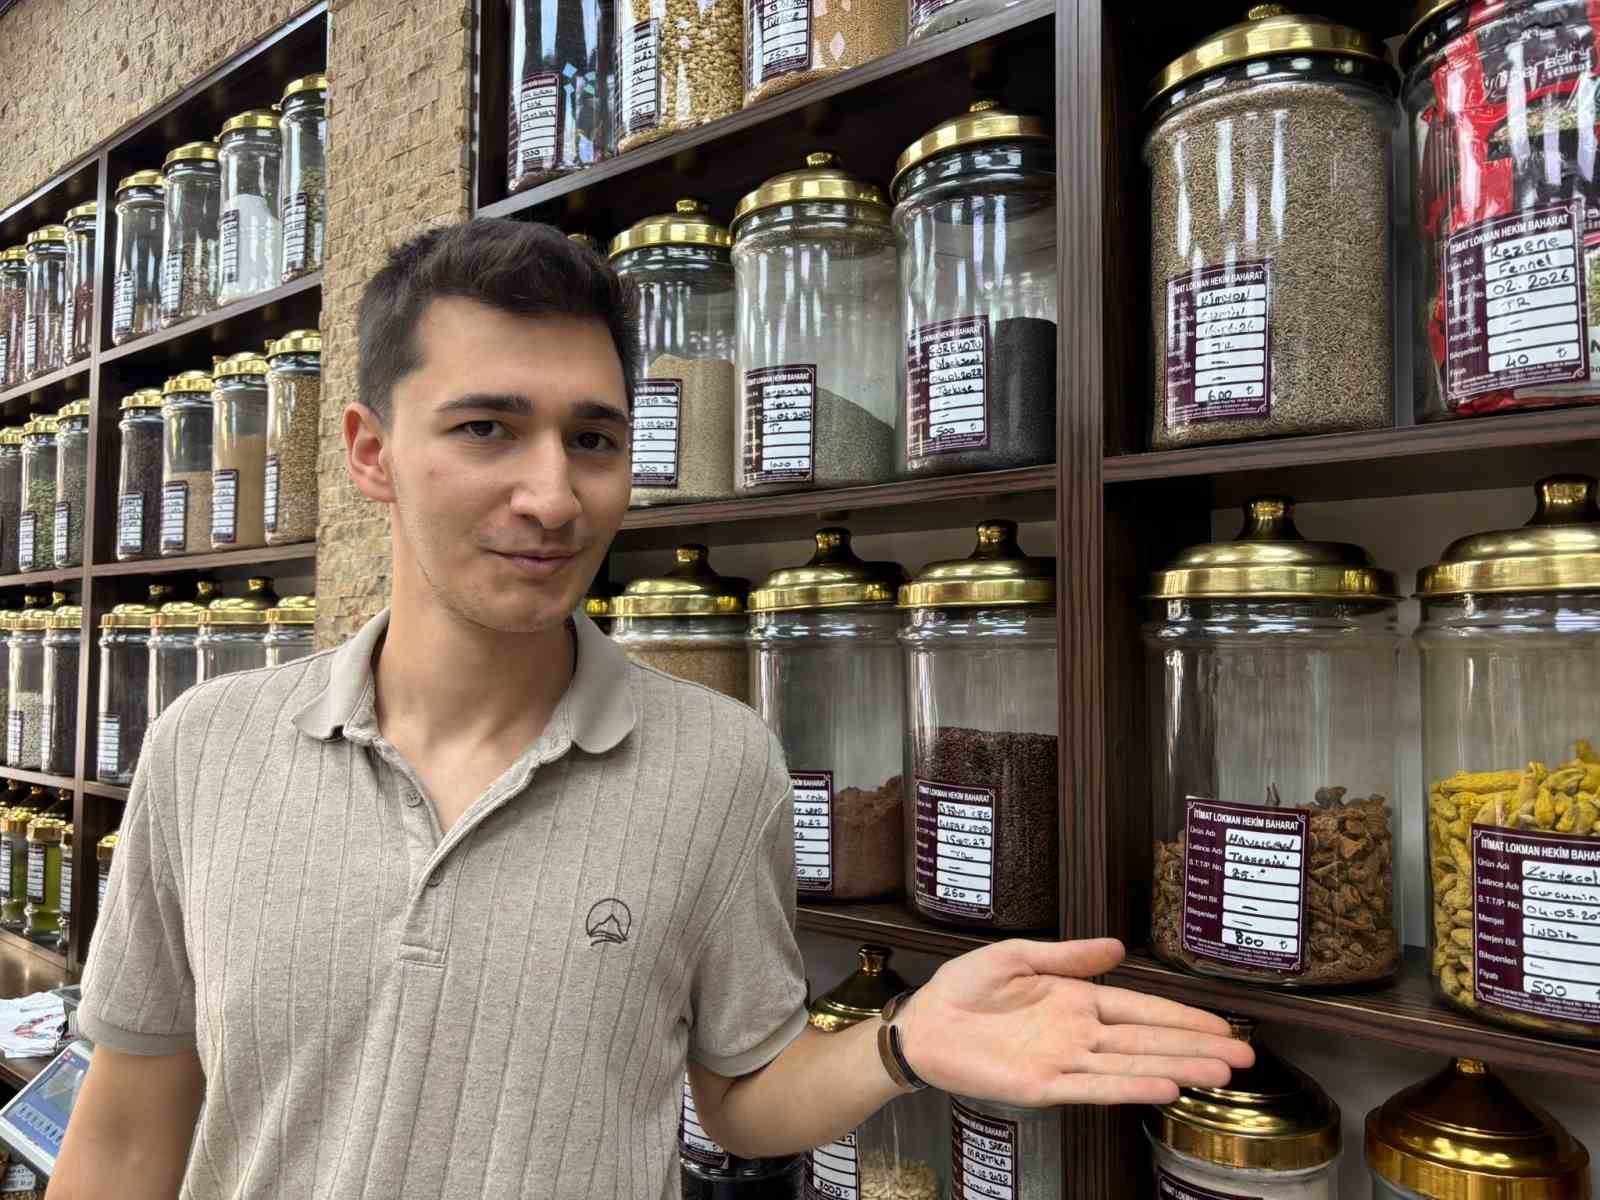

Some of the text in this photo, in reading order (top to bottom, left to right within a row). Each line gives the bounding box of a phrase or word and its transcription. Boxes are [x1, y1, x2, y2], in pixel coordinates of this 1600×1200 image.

[1470, 230, 1500, 248] LOKMAN
[1501, 221, 1528, 239] HEKİM
[1527, 214, 1569, 233] BAHARAT
[1490, 238, 1560, 259] Rezene
[1499, 255, 1553, 275] Fennel
[1230, 270, 1264, 284] BAHARAT
[1528, 270, 1571, 289] 2026
[1504, 353, 1530, 368] 40
[964, 793, 990, 802] BAHARAT
[1193, 809, 1299, 831] İTİMAT LOKMAN HEKİM BAHARAT
[1480, 838, 1504, 853] İTİMAT
[1505, 842, 1540, 858] LOKMAN
[1541, 845, 1570, 859] HEKİM
[1496, 861, 1510, 871] Adı
[1477, 876, 1520, 891] Latince Adı
[1234, 929, 1265, 948] 800
[1478, 932, 1504, 945] Alerjen
[1530, 980, 1568, 998] 500
